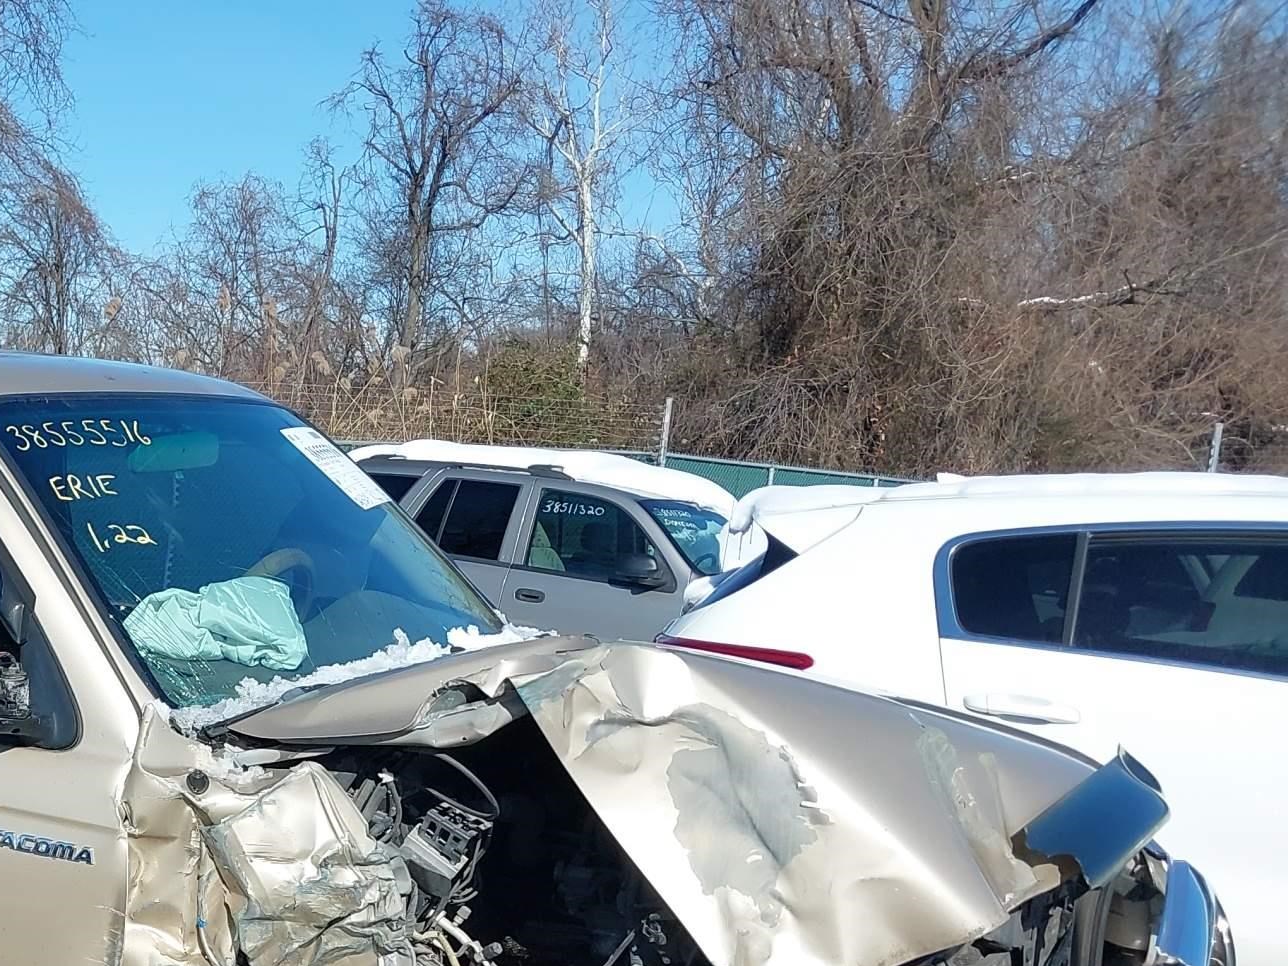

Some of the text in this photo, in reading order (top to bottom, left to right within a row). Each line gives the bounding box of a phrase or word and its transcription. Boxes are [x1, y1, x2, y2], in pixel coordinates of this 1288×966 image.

[6, 419, 152, 451] 38555516
[48, 474, 118, 501] ERIE
[542, 499, 605, 516] 38511320
